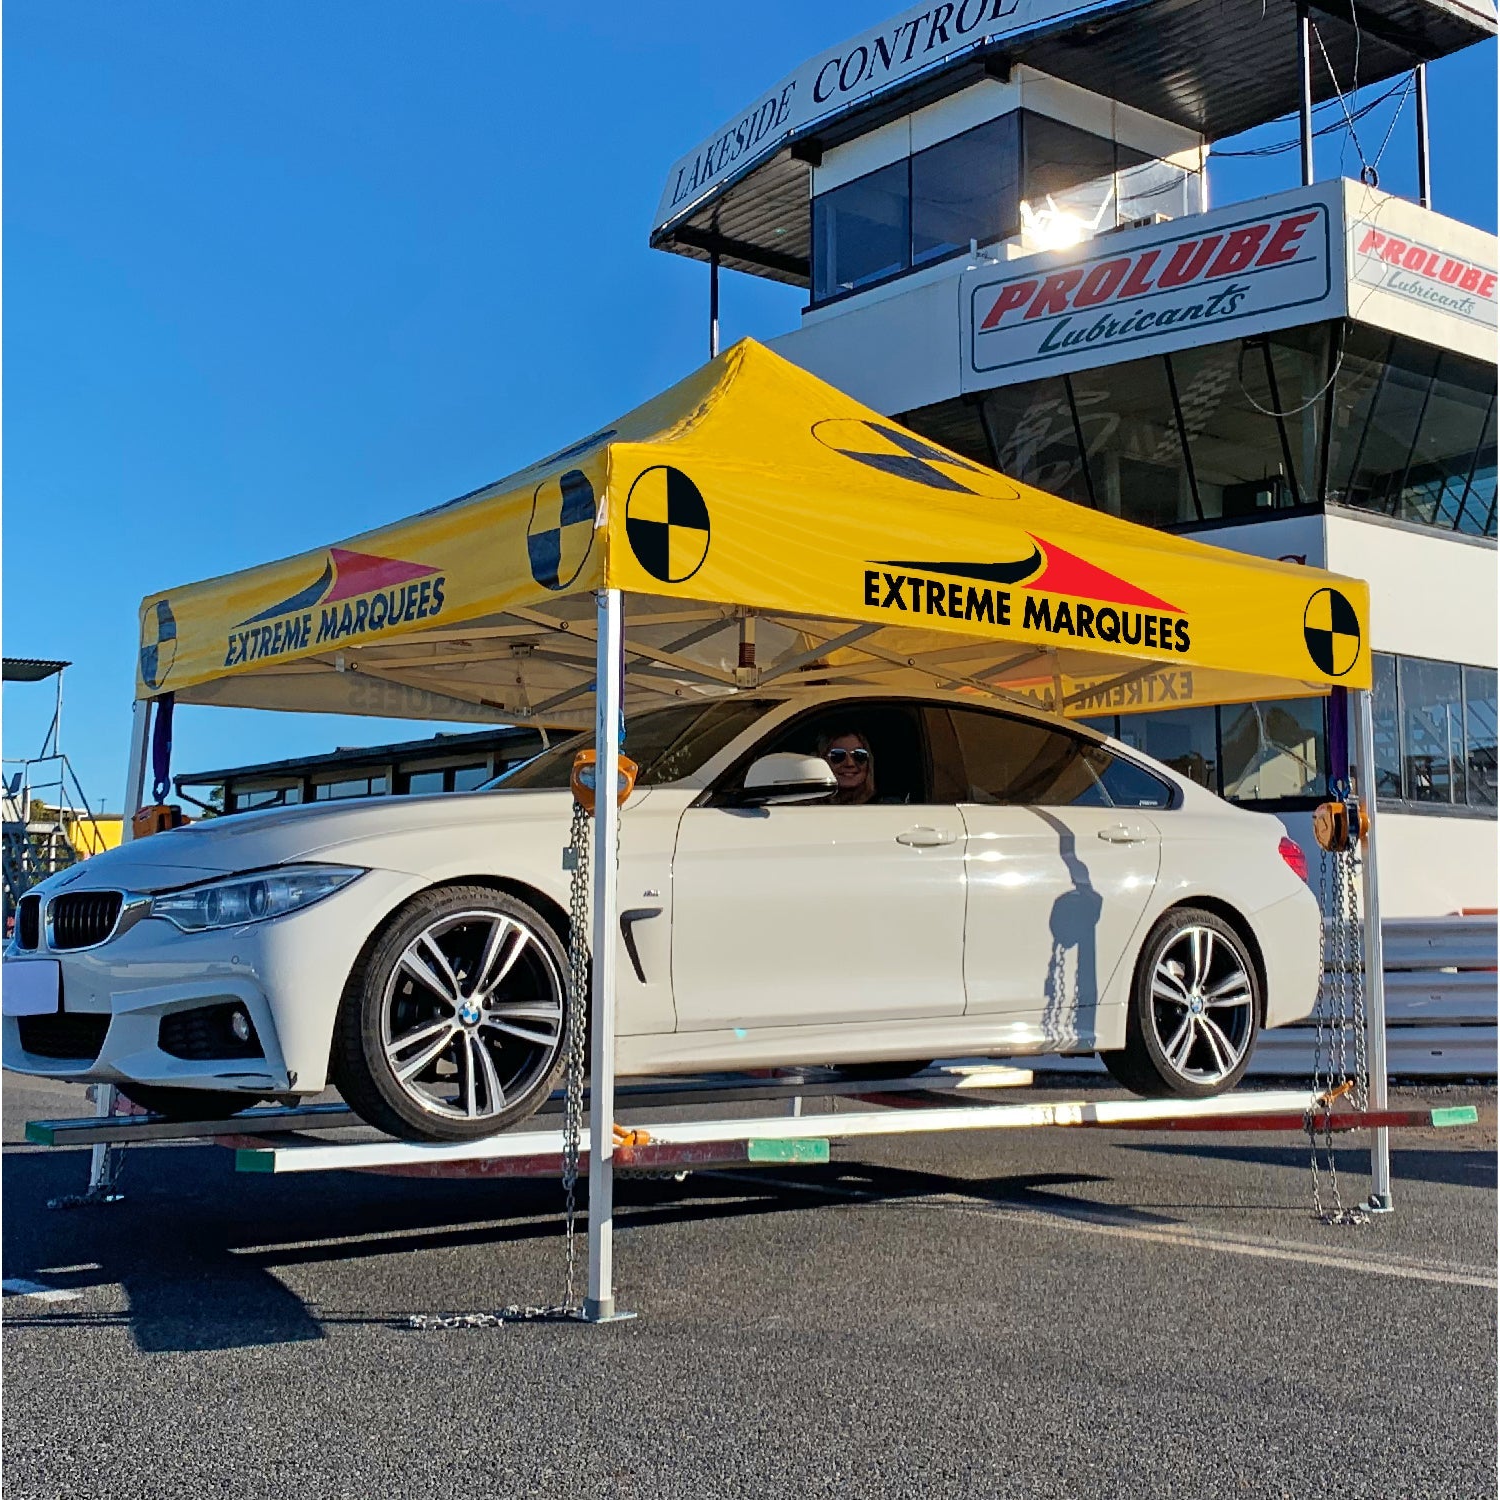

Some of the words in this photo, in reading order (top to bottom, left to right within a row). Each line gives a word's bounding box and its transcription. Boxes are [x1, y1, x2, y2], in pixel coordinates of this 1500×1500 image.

[670, 80, 796, 208] LAKESIDE
[980, 211, 1320, 330] PROLUBE
[1358, 230, 1498, 298] PROLUBE
[1388, 270, 1476, 315] Lubricants
[1038, 284, 1252, 354] Lubricants
[224, 614, 312, 667] EXTREME
[316, 577, 445, 643] MARQUEES
[864, 570, 1011, 626] EXTREME
[1022, 596, 1191, 652] MARQUEES
